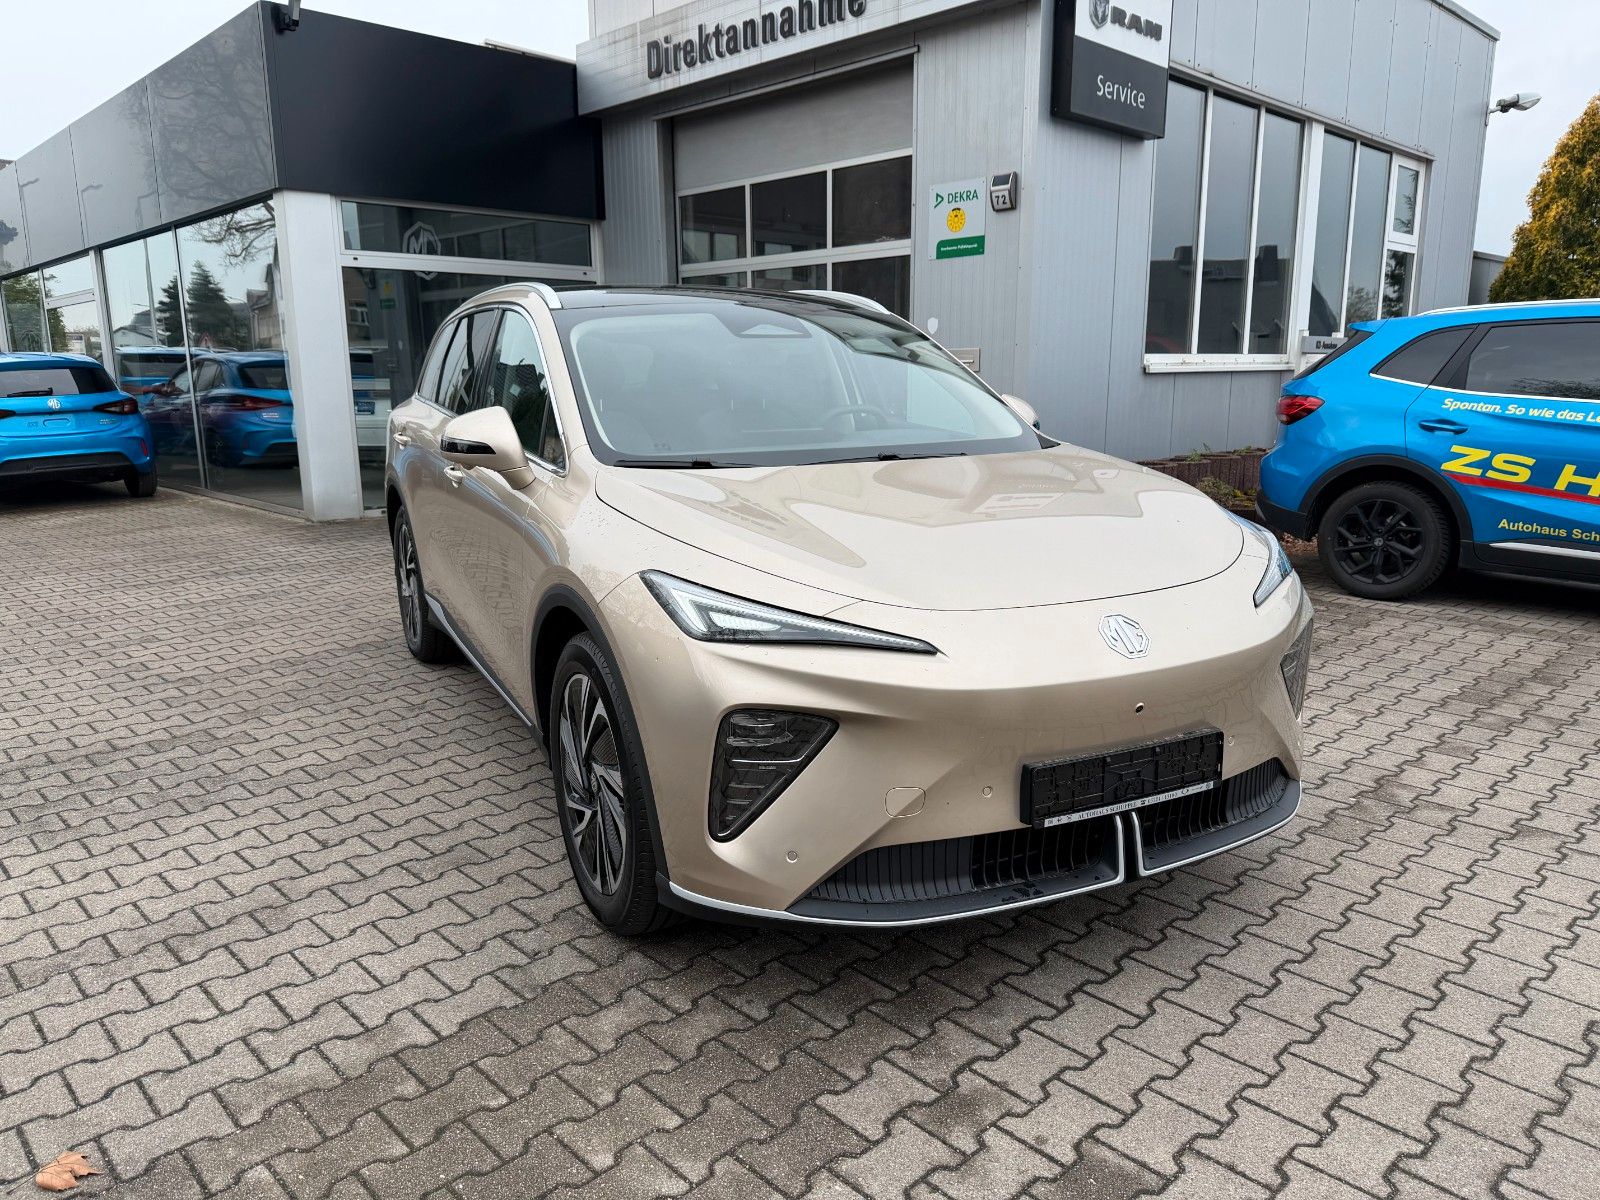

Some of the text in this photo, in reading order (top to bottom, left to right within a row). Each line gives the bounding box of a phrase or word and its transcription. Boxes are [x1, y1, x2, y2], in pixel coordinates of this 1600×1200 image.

[1110, 5, 1163, 42] RAM
[1096, 74, 1146, 109] Service
[947, 189, 979, 204] DEKRA
[994, 194, 1008, 206] 72
[47, 397, 61, 410] MG
[1441, 398, 1502, 412] Spontan.
[1505, 403, 1526, 416] So
[1528, 406, 1555, 418] wie
[1557, 409, 1586, 421] das
[1440, 444, 1600, 498] ZS H
[1498, 518, 1600, 542] Autohaus Sch
